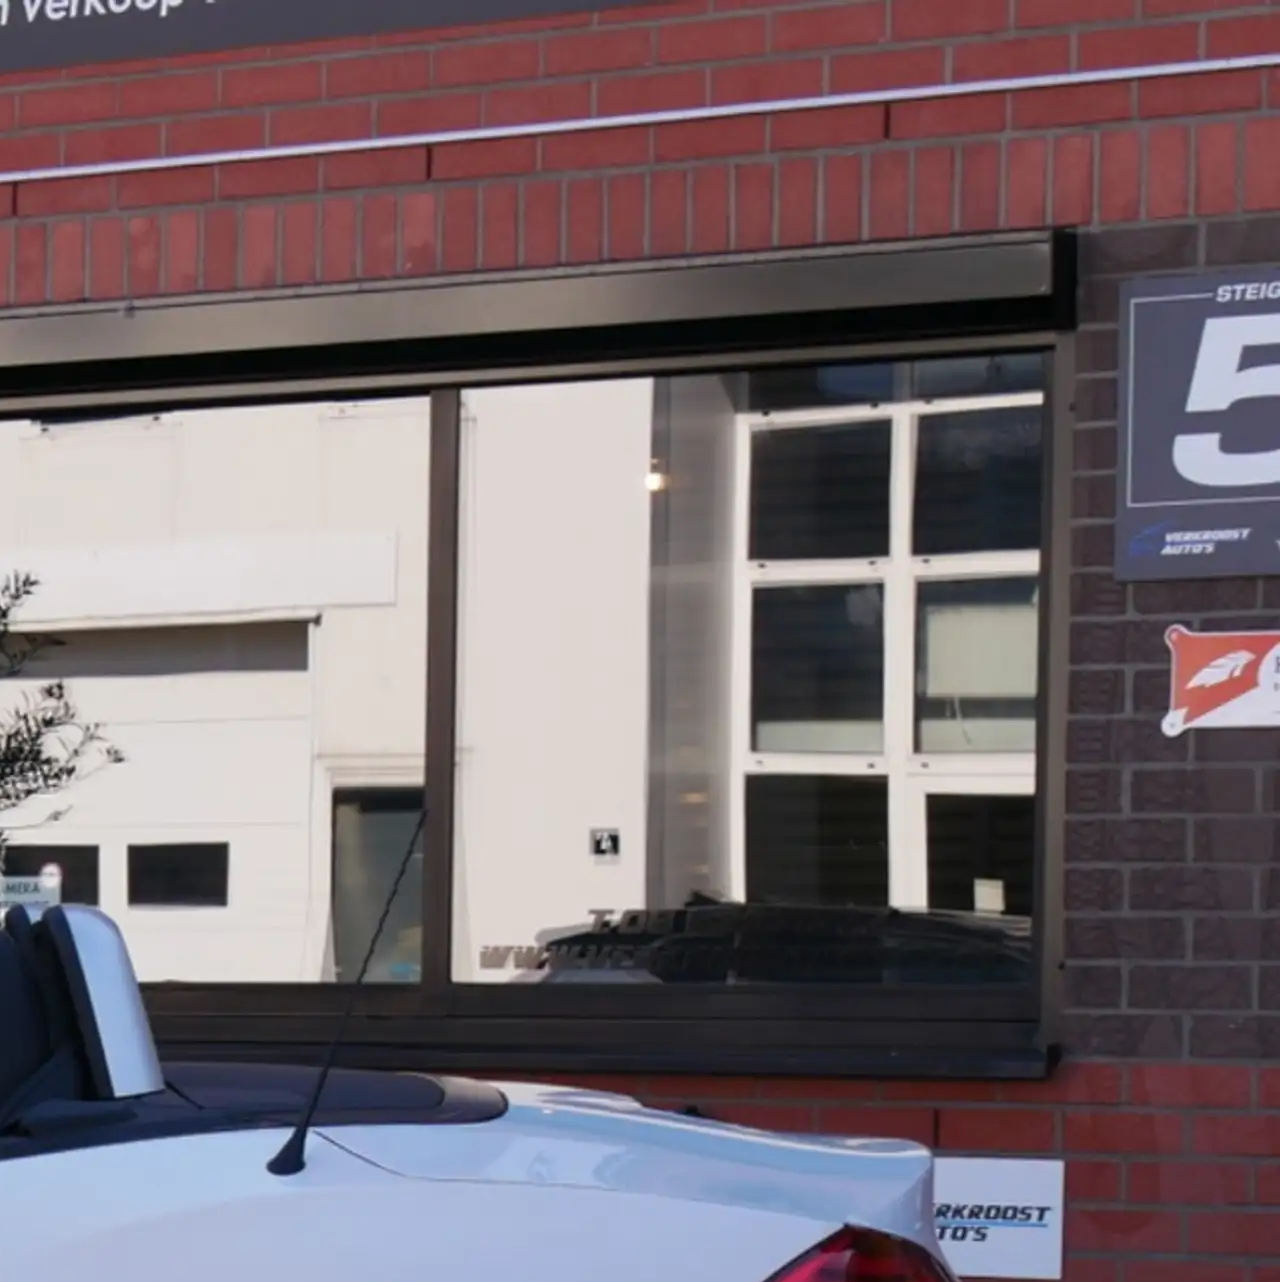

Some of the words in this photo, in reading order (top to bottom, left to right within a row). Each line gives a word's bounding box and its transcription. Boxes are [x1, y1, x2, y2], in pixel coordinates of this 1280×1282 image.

[1172, 313, 1280, 487] 5
[935, 1203, 1052, 1222] RKROOST
[938, 1225, 988, 1242] TO'S
